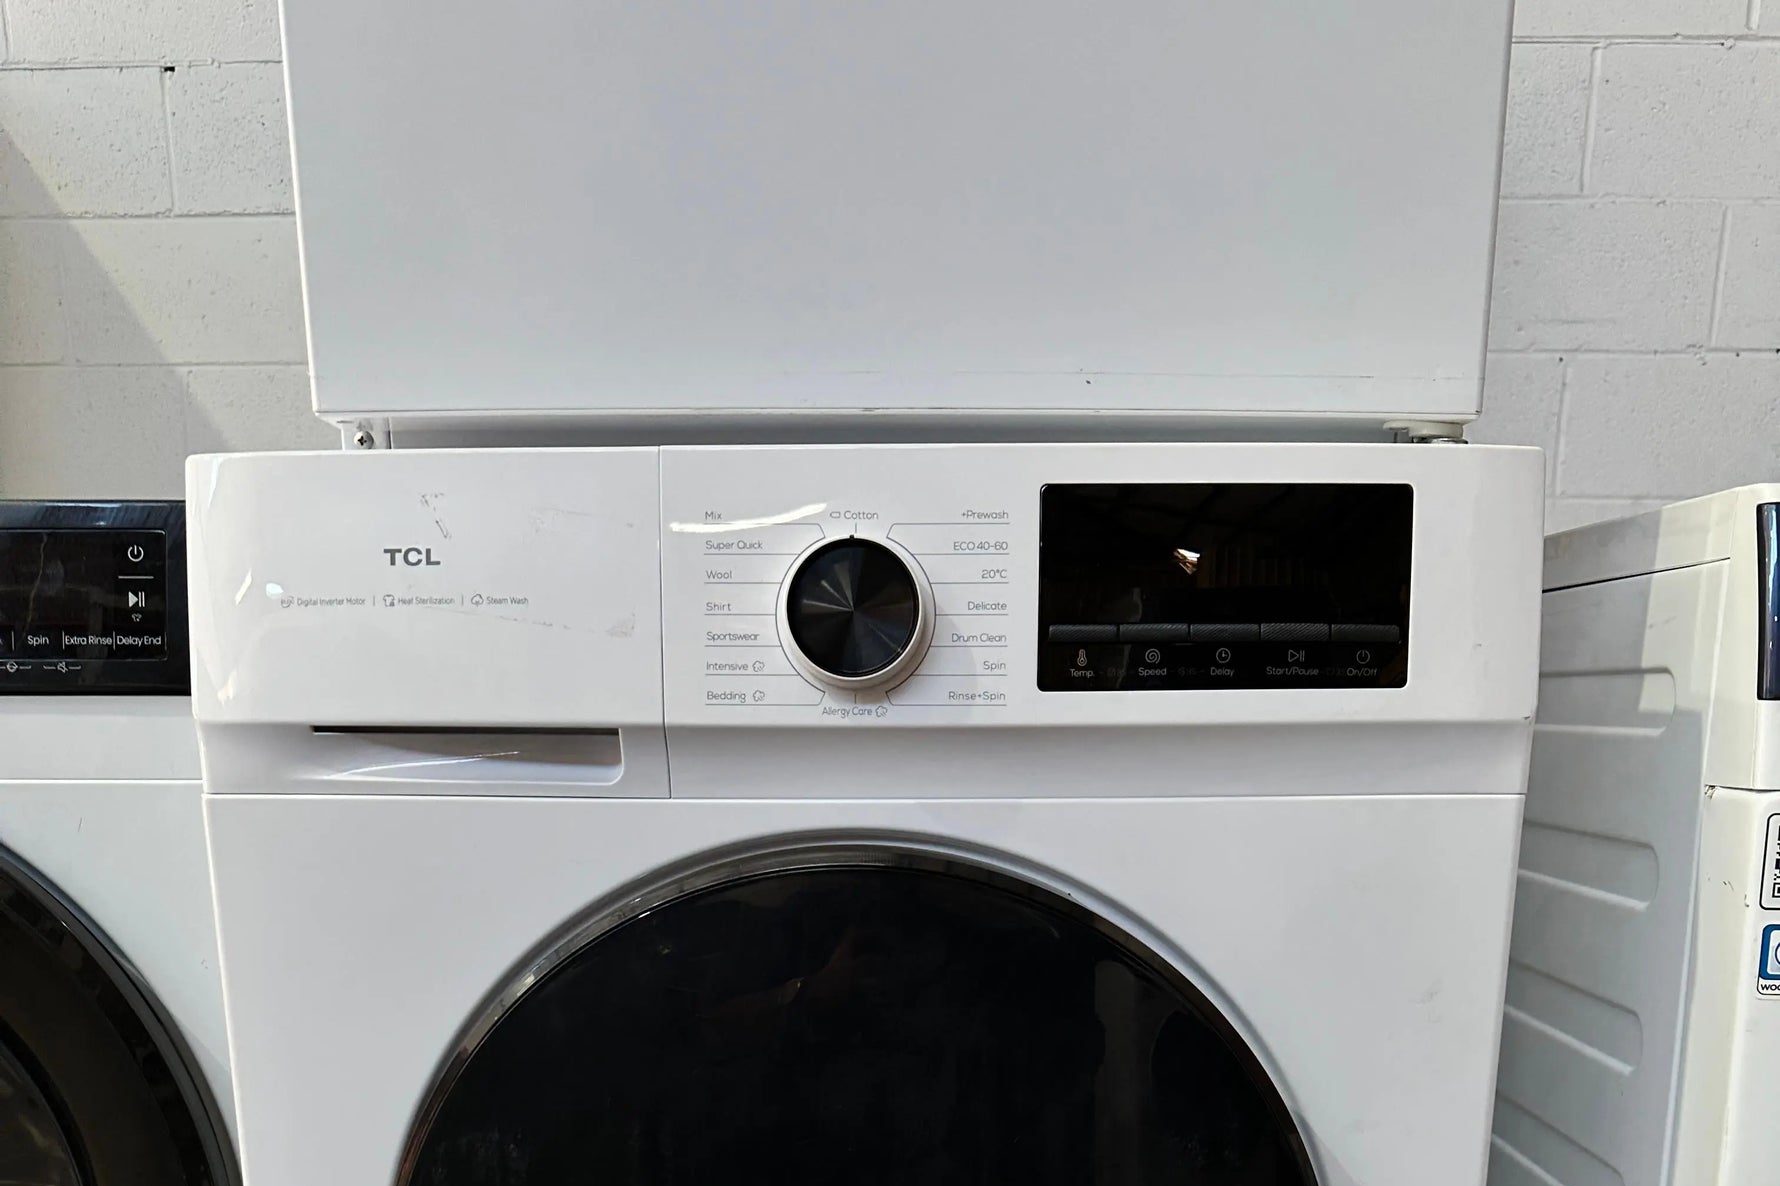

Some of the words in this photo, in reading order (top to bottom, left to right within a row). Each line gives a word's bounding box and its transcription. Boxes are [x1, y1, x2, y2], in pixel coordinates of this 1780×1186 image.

[705, 511, 722, 521] Mix
[843, 510, 878, 520] Cotton
[961, 510, 1009, 520] +Prewash
[705, 541, 734, 551] Super
[737, 541, 763, 550] Quick
[953, 541, 976, 551] ECO
[977, 541, 1008, 551] 40-60
[383, 547, 441, 566] TCL
[706, 570, 732, 580] Wool
[981, 569, 1008, 579] 20°C
[297, 597, 319, 607] Digital
[320, 597, 345, 606] Inverter
[346, 597, 366, 606] Motor
[398, 597, 414, 605] Heat
[415, 596, 455, 605] Sterilization
[486, 596, 509, 605] Steam
[509, 596, 529, 605] Wash
[706, 602, 732, 612] Shirt
[967, 601, 1007, 611] Delicate
[27, 635, 49, 646] Spin
[65, 635, 87, 645] Extra
[88, 635, 113, 645] Rinse
[117, 635, 143, 646] Delay
[144, 635, 162, 645] End
[706, 632, 760, 642] Sportswear
[951, 633, 978, 643] Drum
[980, 633, 1007, 643] Clean
[706, 661, 749, 671] Intensive
[983, 661, 1006, 672] Spin
[1266, 666, 1319, 676] Start/Pause
[1069, 668, 1095, 678] Temp.
[1138, 667, 1167, 677] Speed
[1210, 667, 1235, 678] Delay
[1347, 667, 1377, 677] On/Off
[707, 691, 746, 702] Bedding
[948, 691, 1006, 702] Rinse+Spin
[822, 706, 850, 718] Allergy
[852, 706, 873, 716] Care
